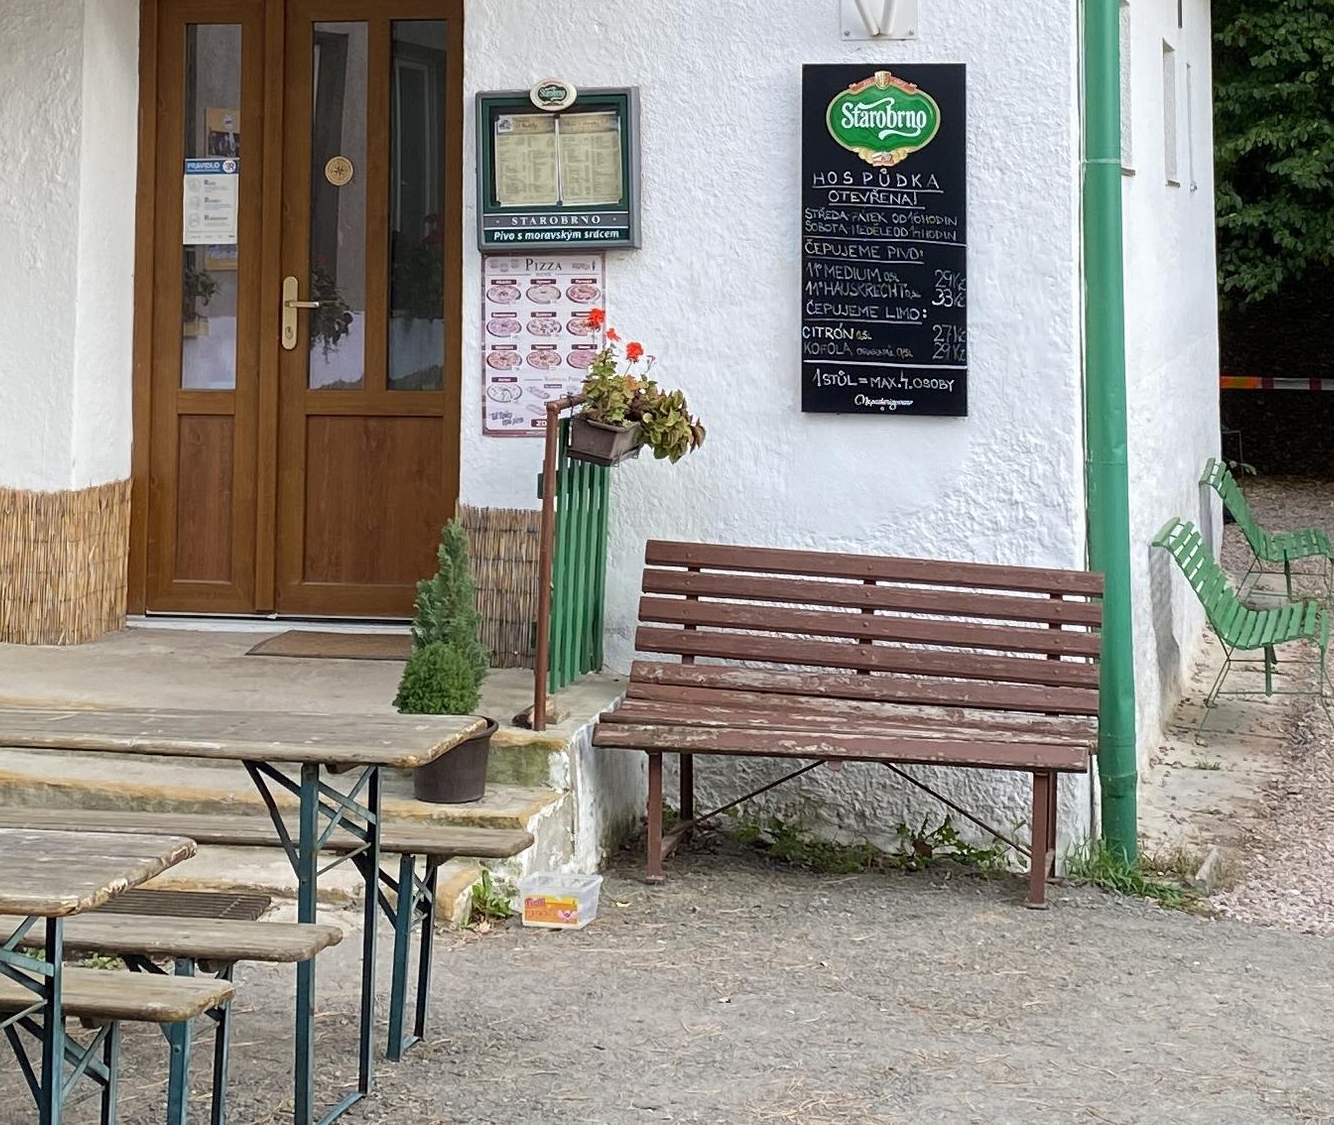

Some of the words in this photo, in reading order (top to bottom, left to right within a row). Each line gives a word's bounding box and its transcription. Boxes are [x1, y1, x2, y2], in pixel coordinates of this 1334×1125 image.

[841, 97, 927, 141] Starobrno
[511, 215, 602, 226] STAROBRNO
[493, 231, 515, 241] Pivo
[524, 230, 582, 242] moravským
[584, 230, 620, 240] srdcem
[804, 239, 880, 259] ČEPUJEME
[805, 299, 880, 319] ČEPUJEME
[802, 323, 855, 341] CITRÓN
[803, 341, 854, 358] KOFOLA
